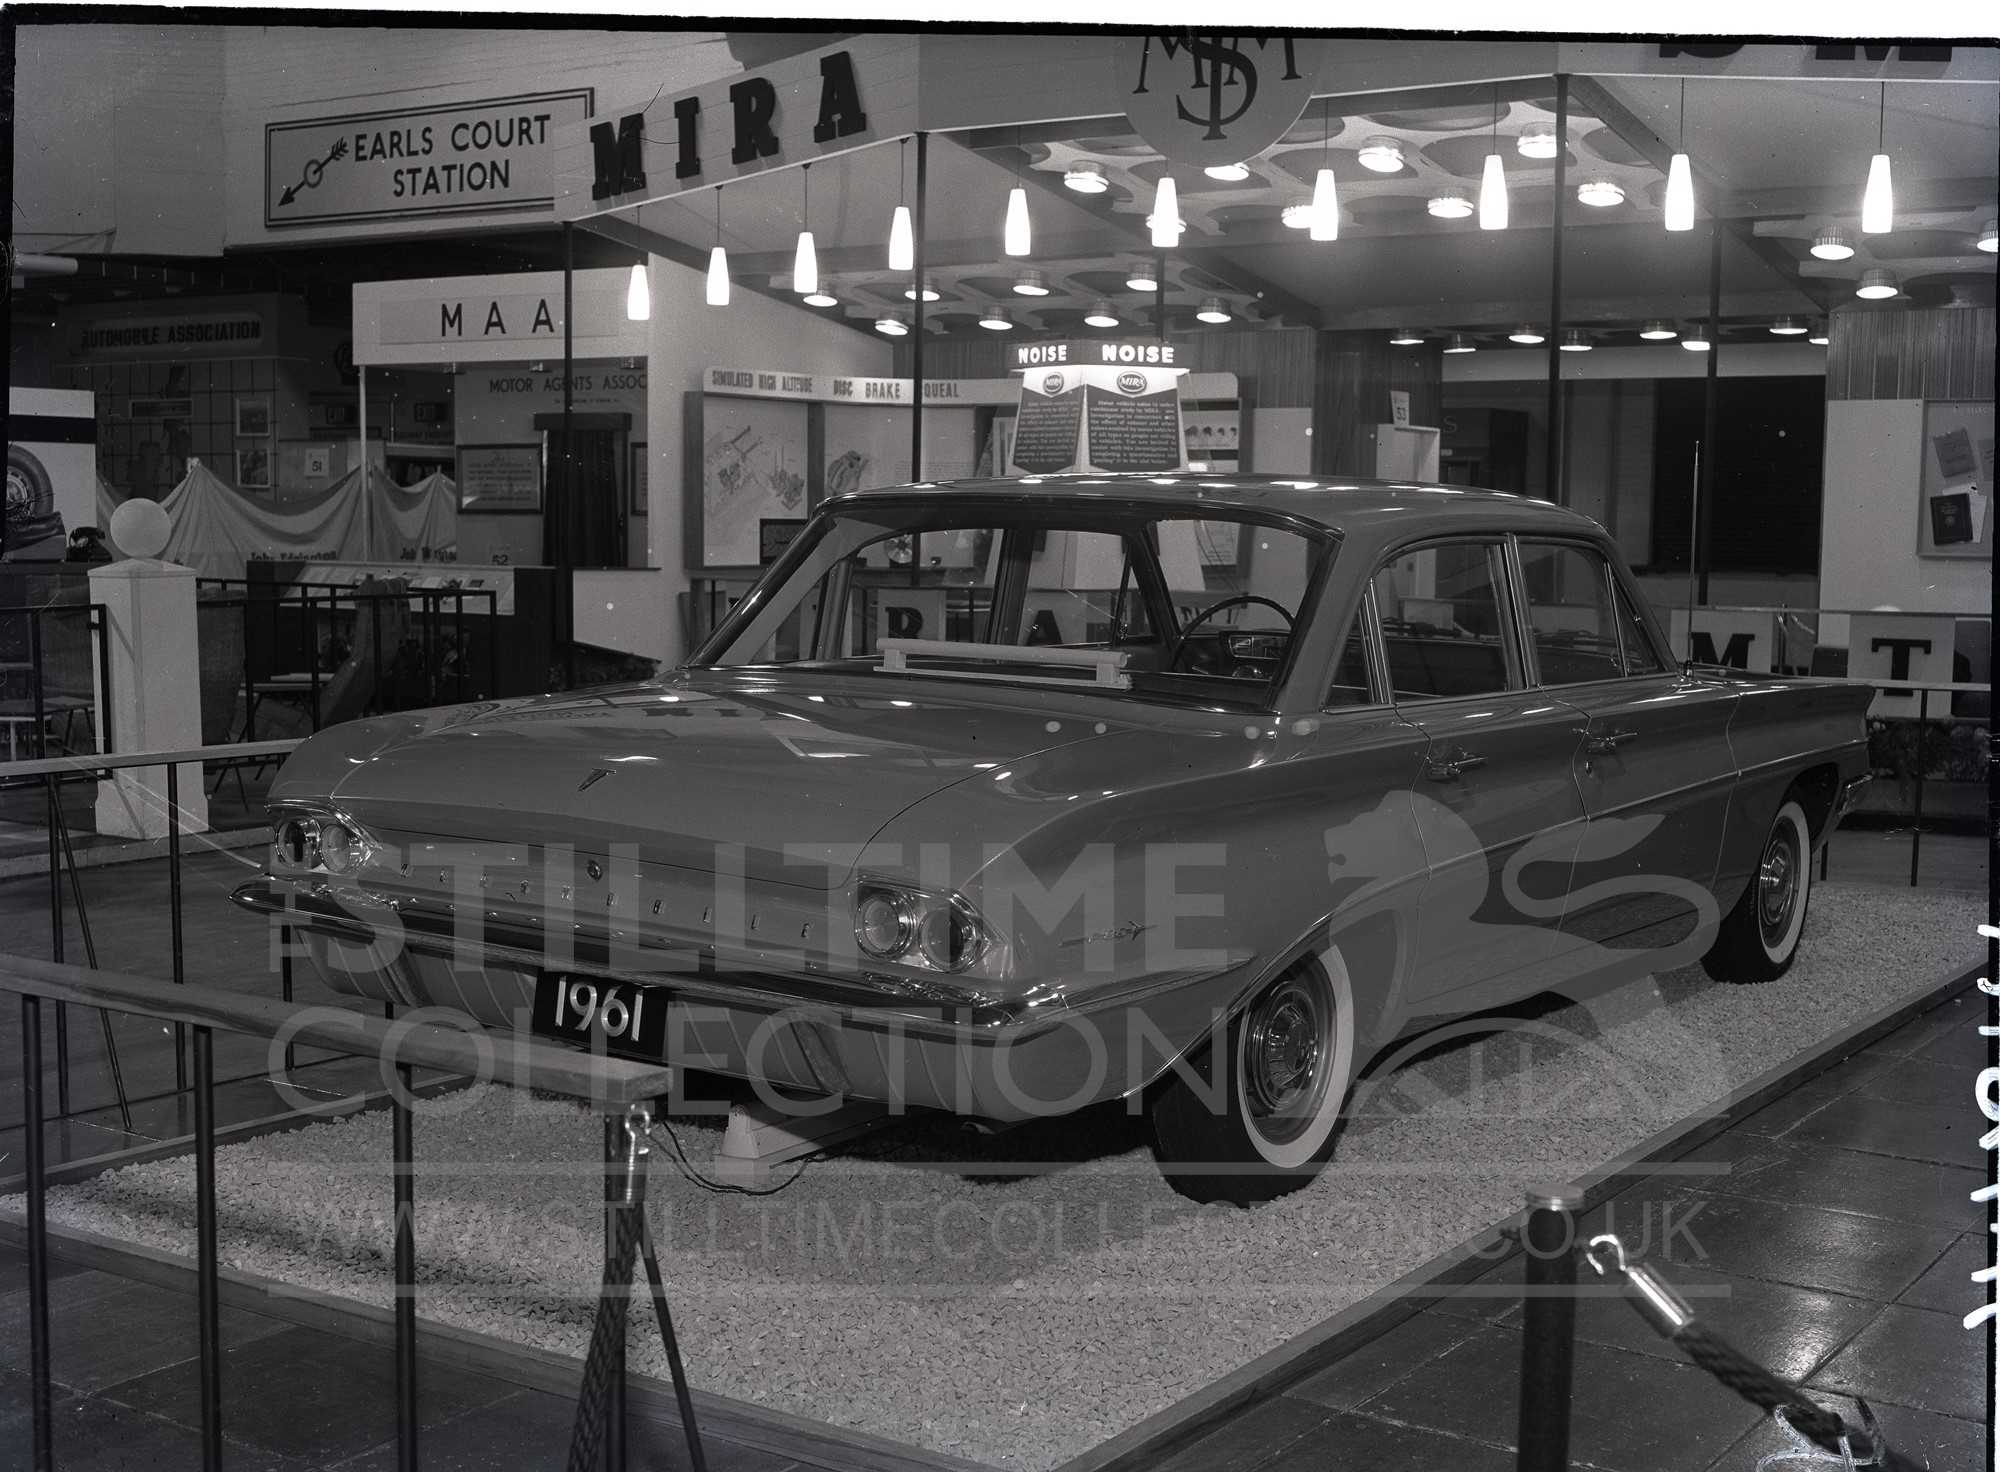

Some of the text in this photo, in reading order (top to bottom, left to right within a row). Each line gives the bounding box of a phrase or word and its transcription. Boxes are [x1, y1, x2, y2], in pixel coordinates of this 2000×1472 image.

[590, 51, 866, 201] MIRA
[354, 114, 551, 162] EARLS COURT
[393, 159, 510, 197] STATION
[167, 320, 261, 343] ASSOCIATION
[1018, 345, 1067, 364] NOISE
[1102, 344, 1174, 363] NOISE
[489, 378, 534, 393] MOTOR
[544, 376, 593, 392] AGNTS
[833, 380, 960, 399] DISC BRAKE QUEAL
[554, 975, 645, 1042] 1961
